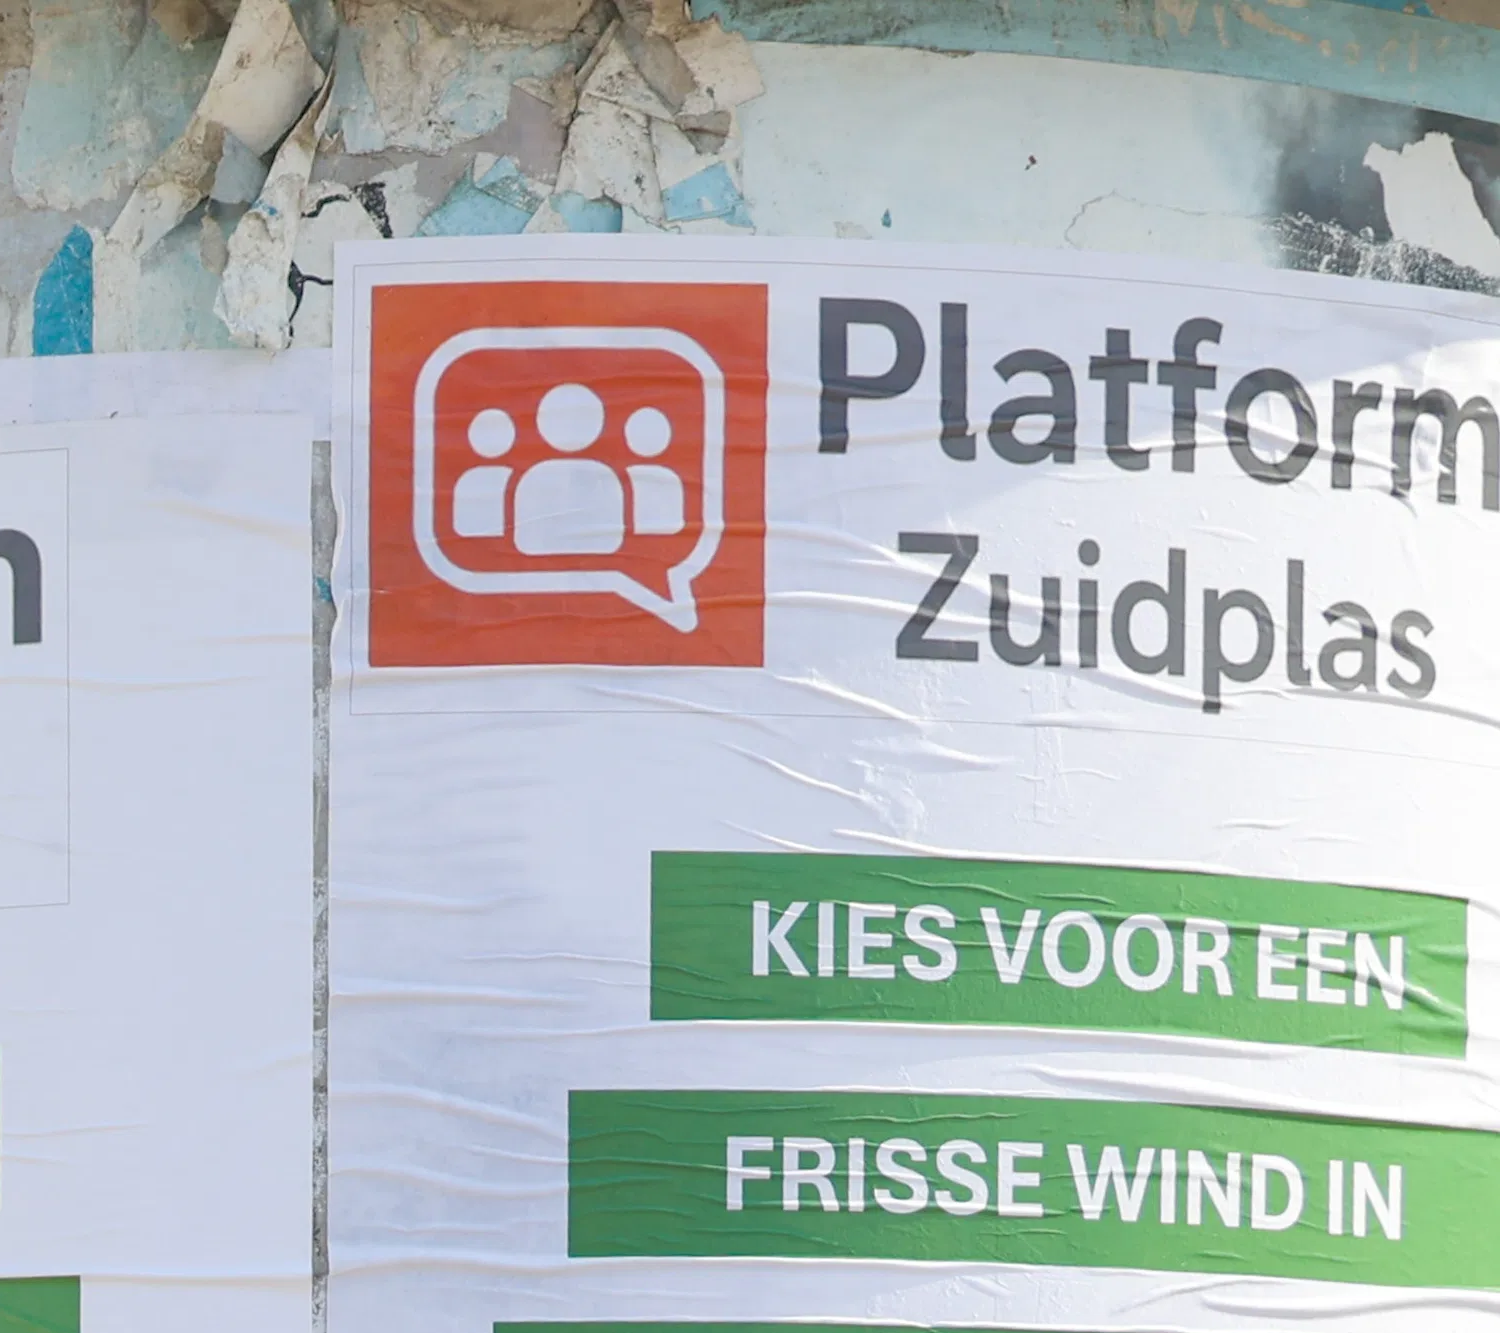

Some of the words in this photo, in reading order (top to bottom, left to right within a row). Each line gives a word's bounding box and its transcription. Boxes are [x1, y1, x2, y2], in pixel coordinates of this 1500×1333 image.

[818, 297, 1500, 512] Platform
[895, 532, 1437, 714] Zuidplas
[751, 900, 958, 981] KIES
[979, 906, 1233, 997] VOOR
[1256, 923, 1404, 1011] EEN
[725, 1136, 1045, 1217] FRISSE
[1066, 1143, 1303, 1233] WIND
[1327, 1159, 1404, 1241] IN
